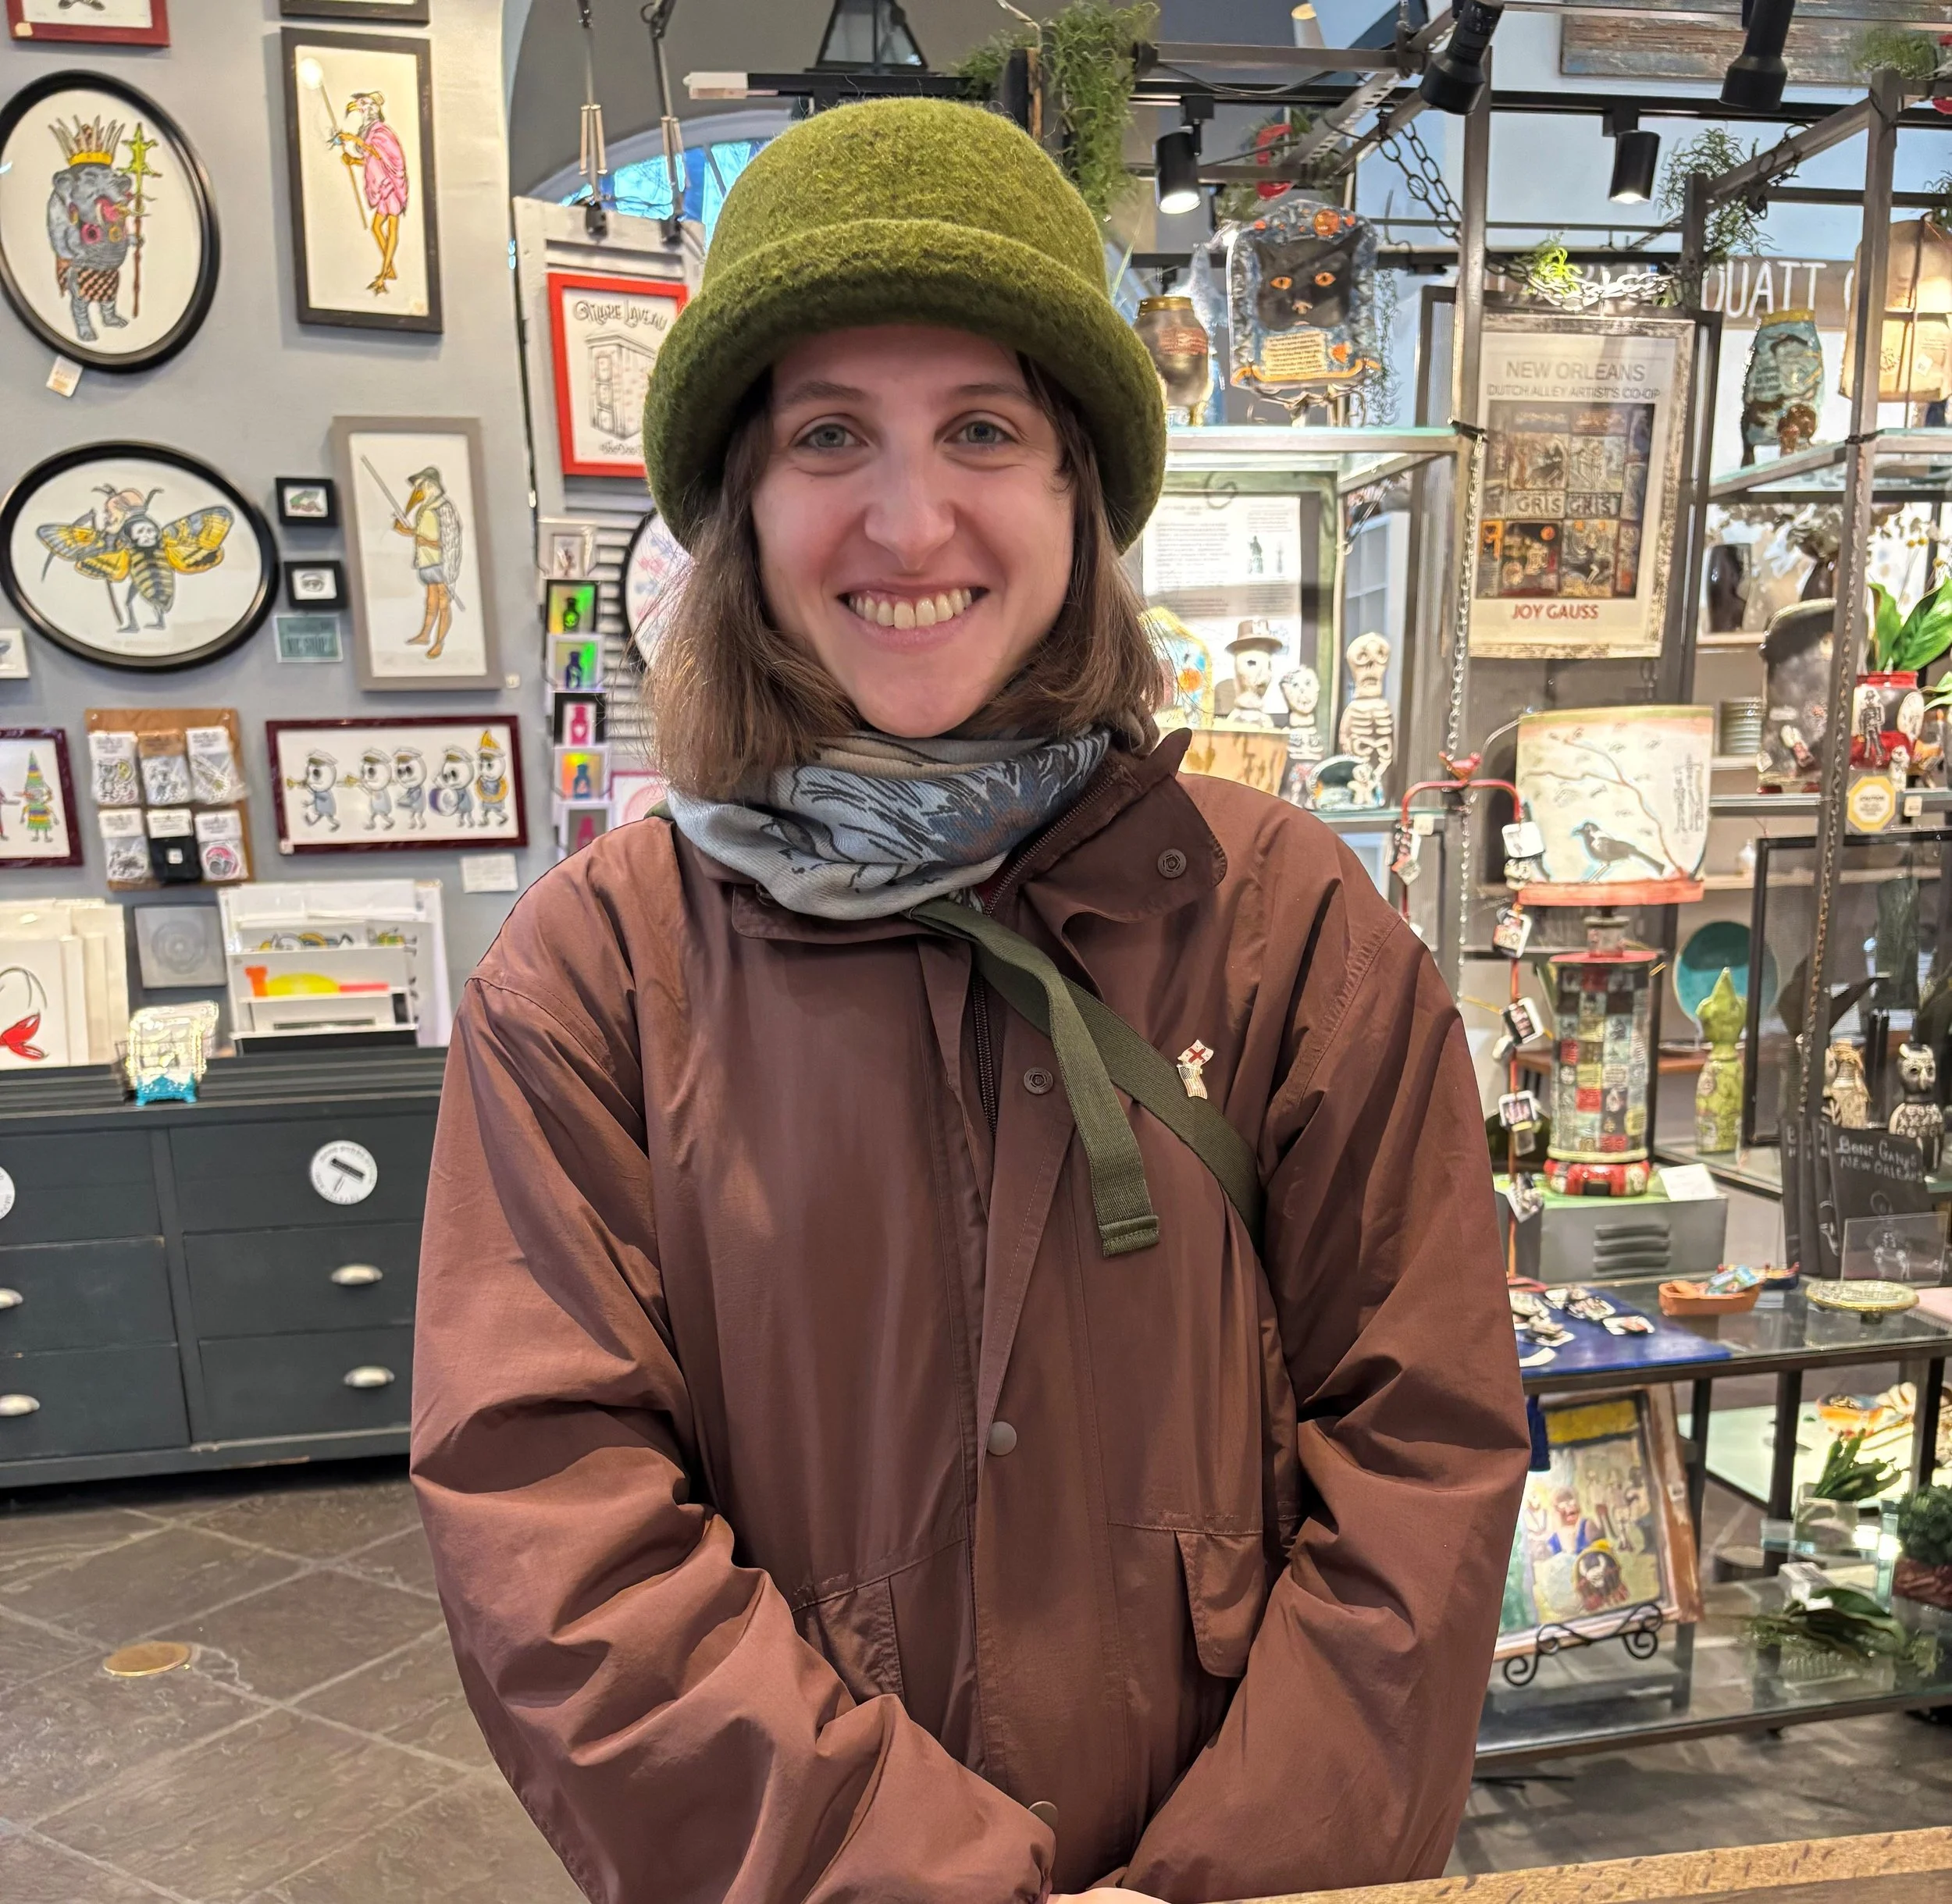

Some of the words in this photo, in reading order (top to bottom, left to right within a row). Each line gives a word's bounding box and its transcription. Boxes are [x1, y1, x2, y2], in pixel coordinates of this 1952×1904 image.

[1506, 361, 1552, 379] NEW
[1555, 361, 1645, 382] ORLEANS
[1487, 383, 1528, 396] DUTCH
[1516, 496, 1562, 513] GRIS
[1512, 603, 1544, 619] JOY
[1546, 603, 1600, 620] GAUSS
